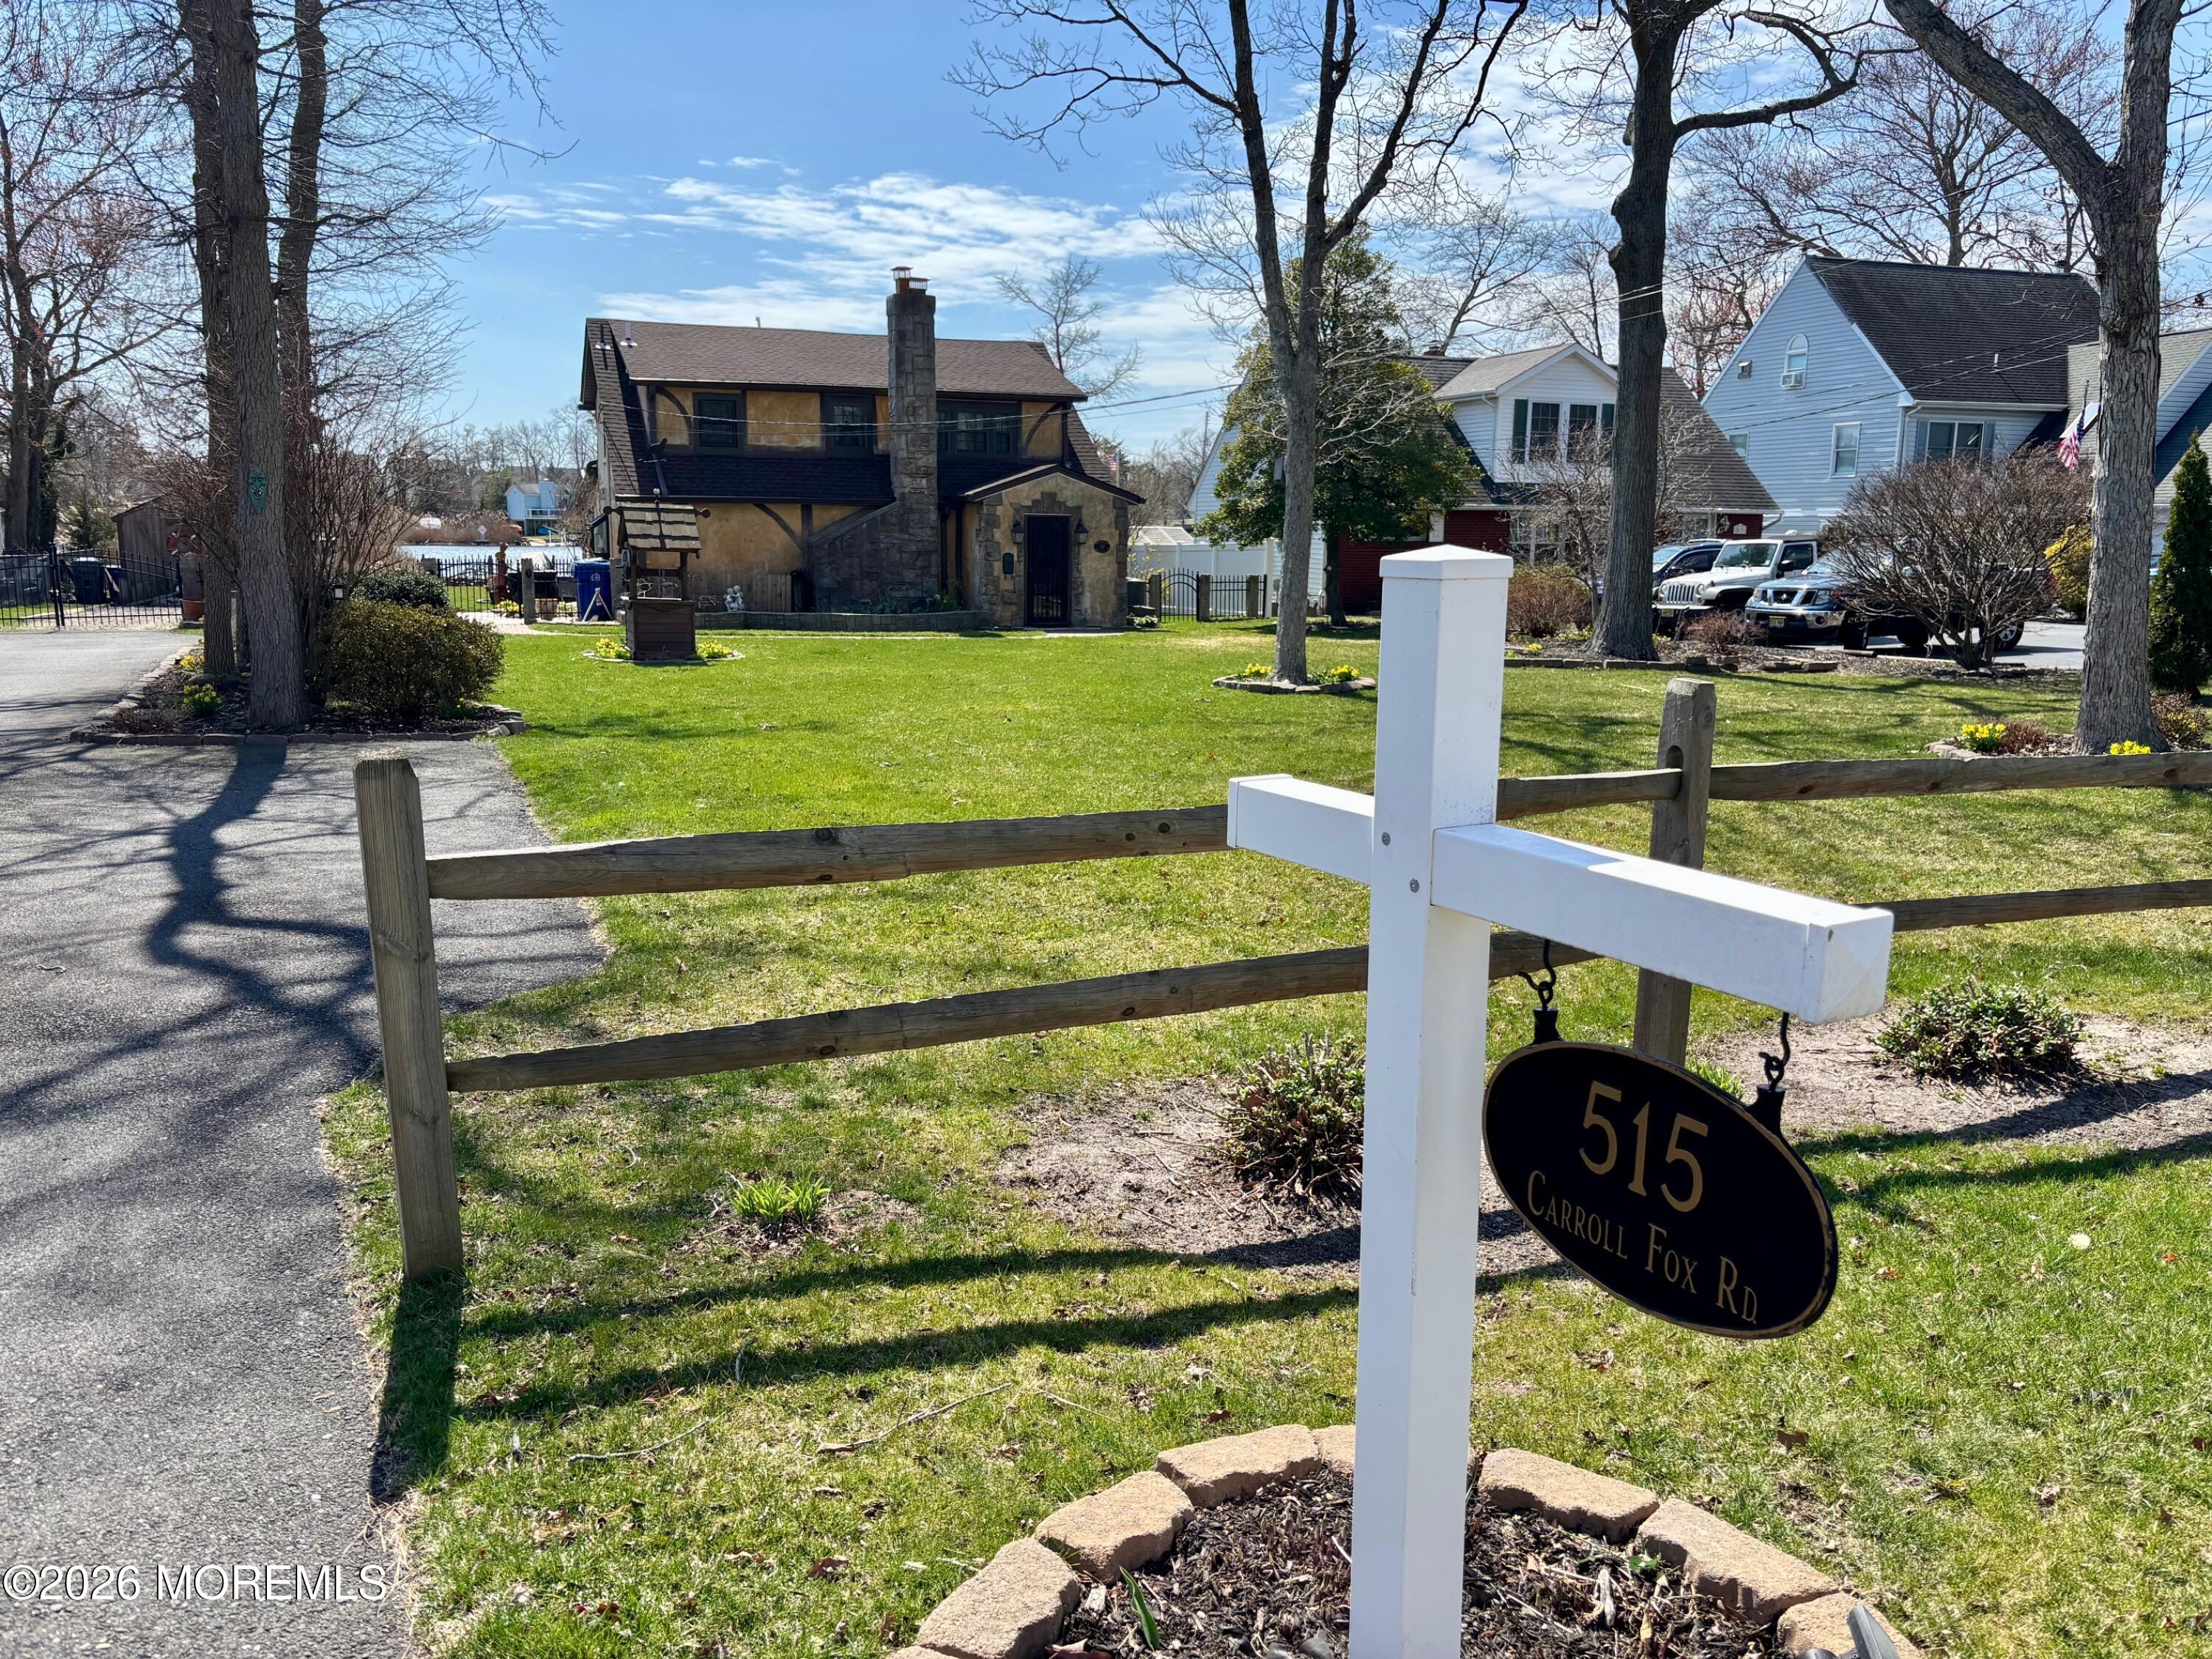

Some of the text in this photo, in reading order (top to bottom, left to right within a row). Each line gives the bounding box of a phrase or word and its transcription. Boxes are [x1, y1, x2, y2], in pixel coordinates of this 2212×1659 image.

[1579, 1080, 1708, 1212] 515
[1527, 1170, 1628, 1259] CARROLL
[1645, 1222, 1697, 1294] FOX
